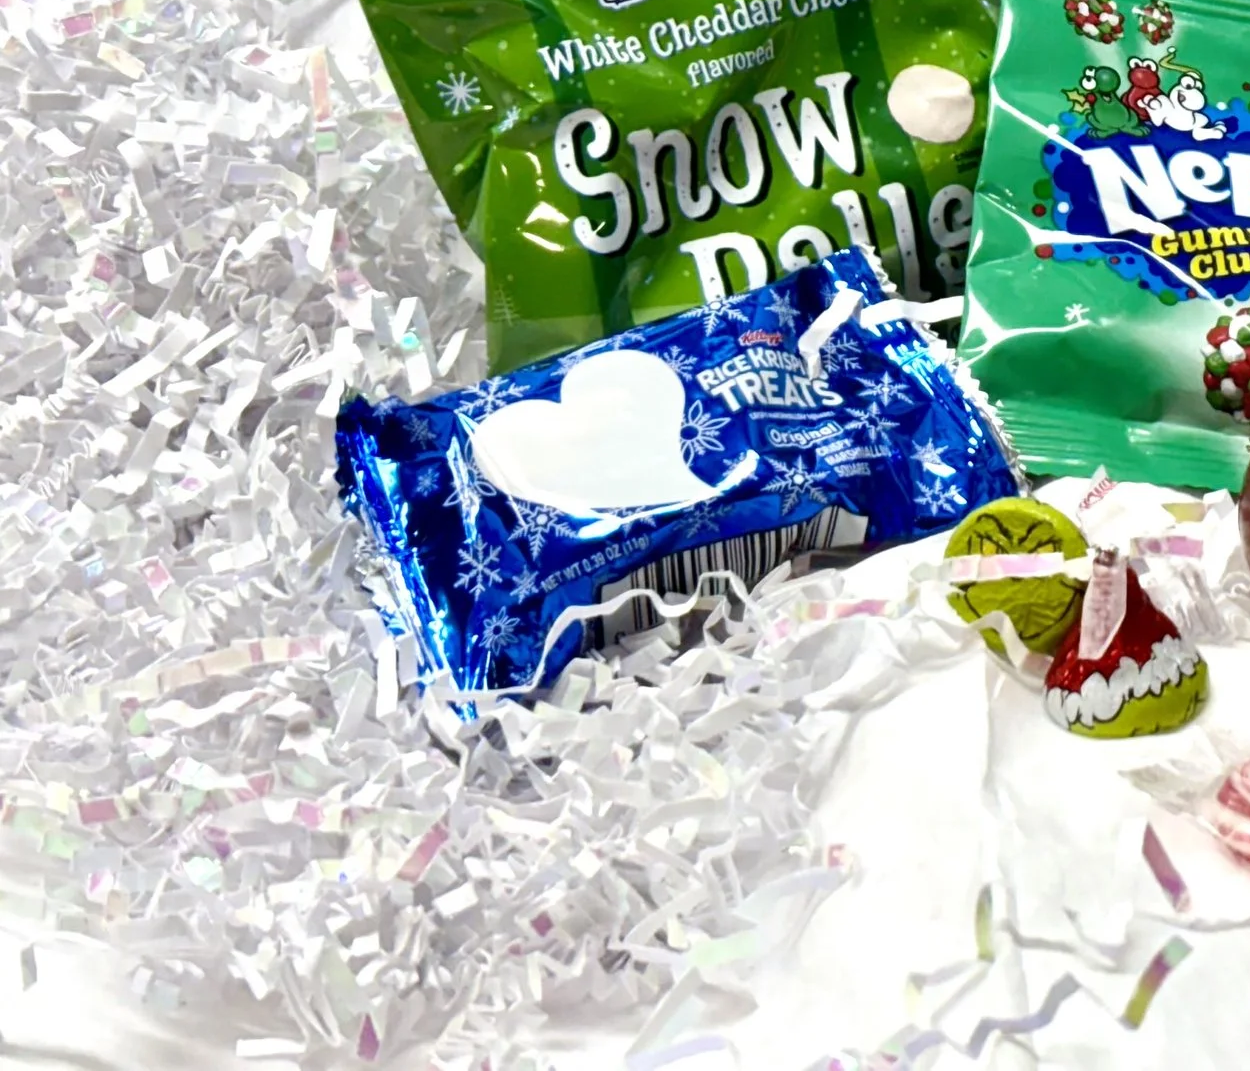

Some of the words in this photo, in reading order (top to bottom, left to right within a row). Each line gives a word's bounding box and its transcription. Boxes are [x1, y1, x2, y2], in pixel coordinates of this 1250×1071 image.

[537, 31, 646, 80] White
[686, 39, 775, 88] flavored
[553, 71, 862, 256] Snow
[697, 353, 752, 391] RICE
[711, 370, 843, 413] TREATS
[769, 422, 838, 446] Original
[541, 573, 562, 592] NET
[563, 562, 581, 580] WT
[605, 543, 621, 560] OZ
[622, 534, 650, 555] (11g)
